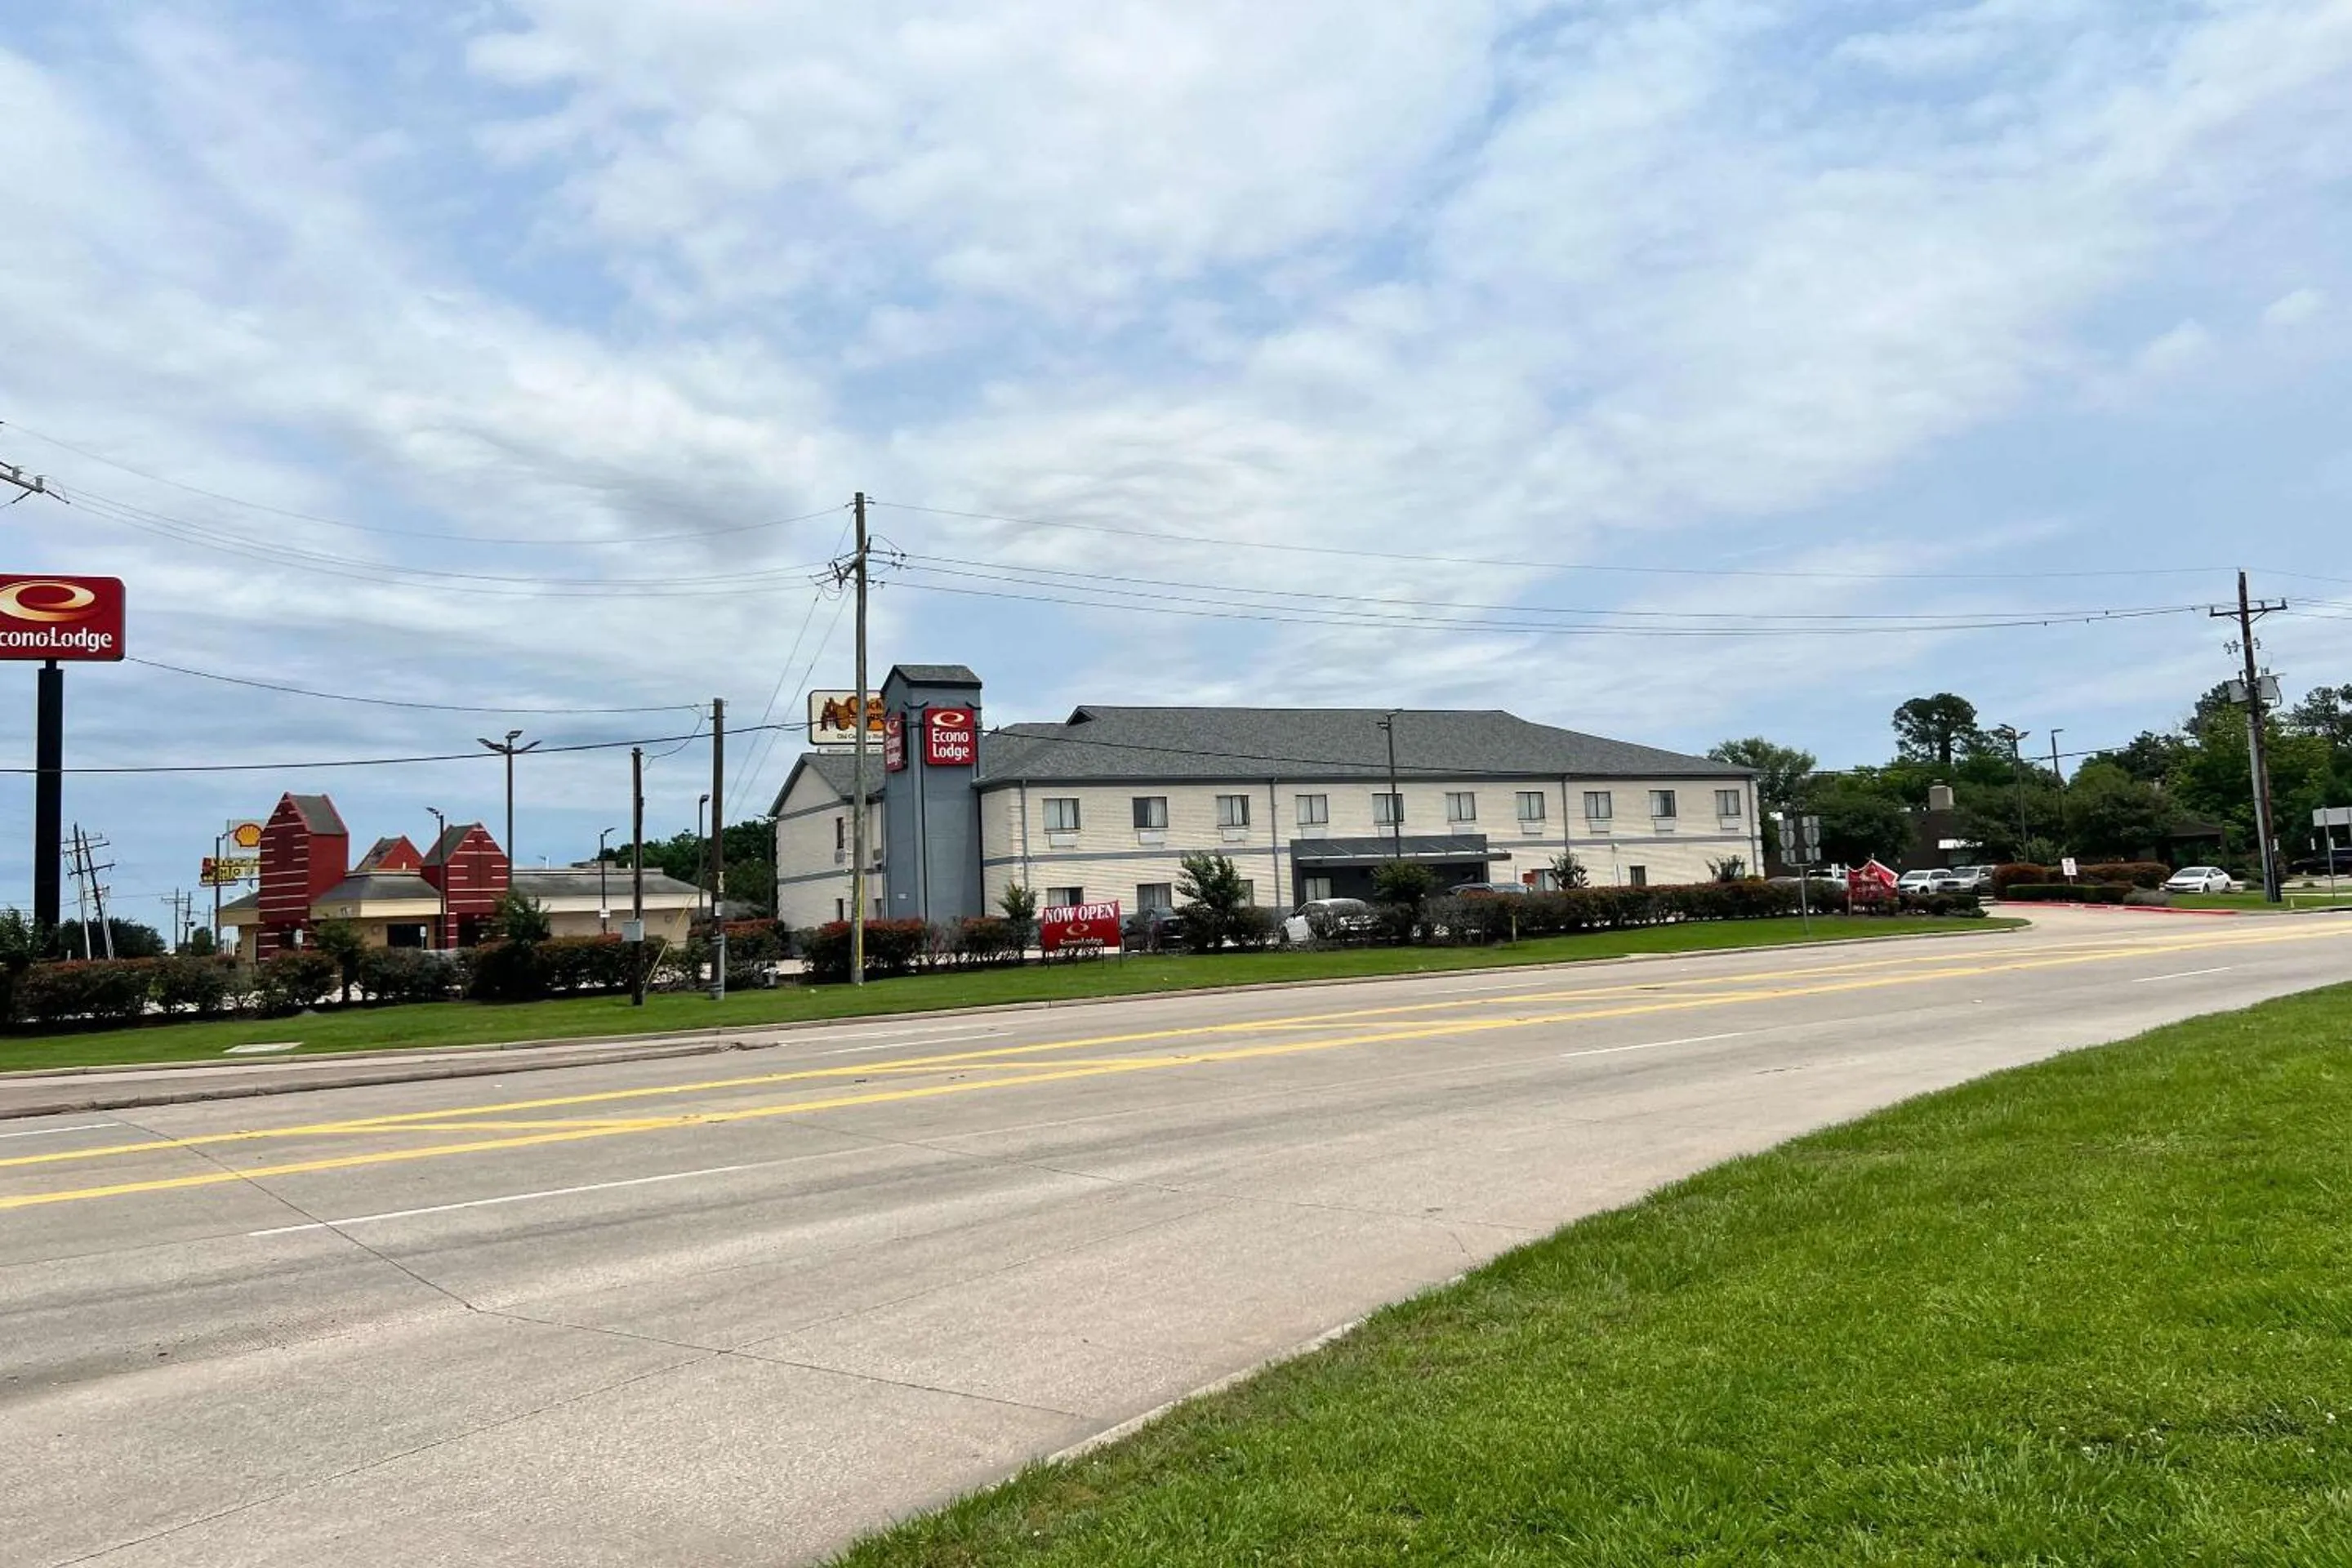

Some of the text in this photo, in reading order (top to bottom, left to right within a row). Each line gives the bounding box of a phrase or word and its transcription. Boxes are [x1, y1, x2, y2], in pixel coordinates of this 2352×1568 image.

[0, 626, 113, 653] conoLodge
[932, 728, 969, 742] Econo
[933, 743, 970, 761] Lodge
[1045, 903, 1116, 924] NOW OPEN
